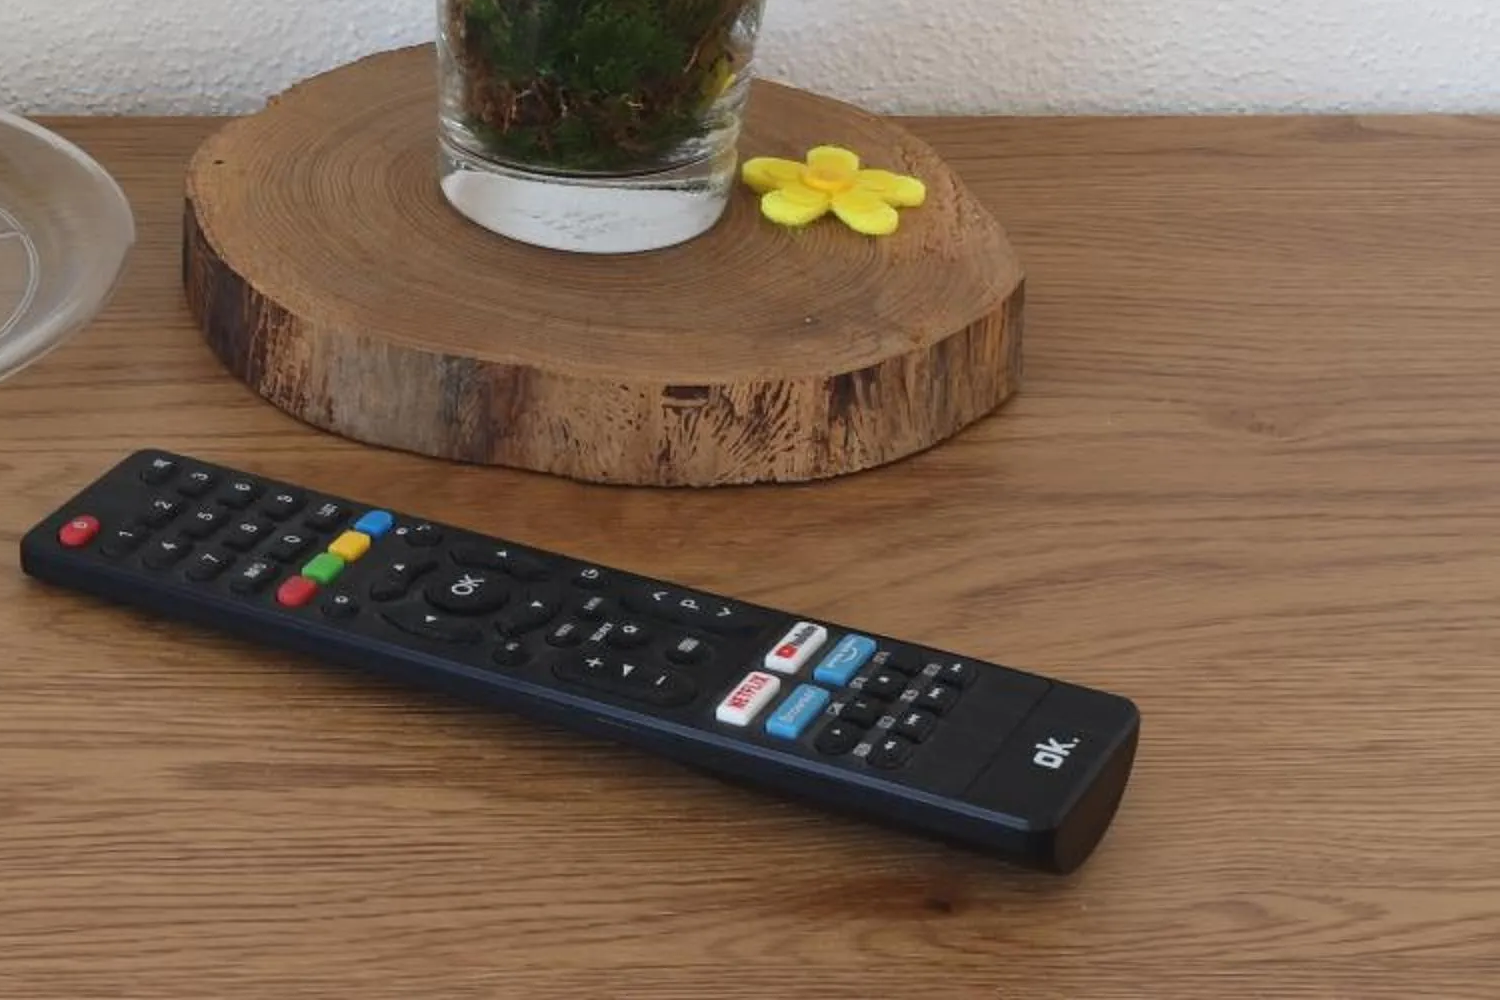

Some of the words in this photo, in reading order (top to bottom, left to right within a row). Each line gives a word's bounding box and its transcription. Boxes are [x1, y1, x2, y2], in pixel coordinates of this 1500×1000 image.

[153, 500, 173, 510] 2
[196, 510, 214, 521] 5
[239, 522, 258, 533] 8
[118, 530, 134, 538] 1
[201, 552, 221, 564] 7
[450, 573, 486, 596] OK
[679, 598, 699, 611] P
